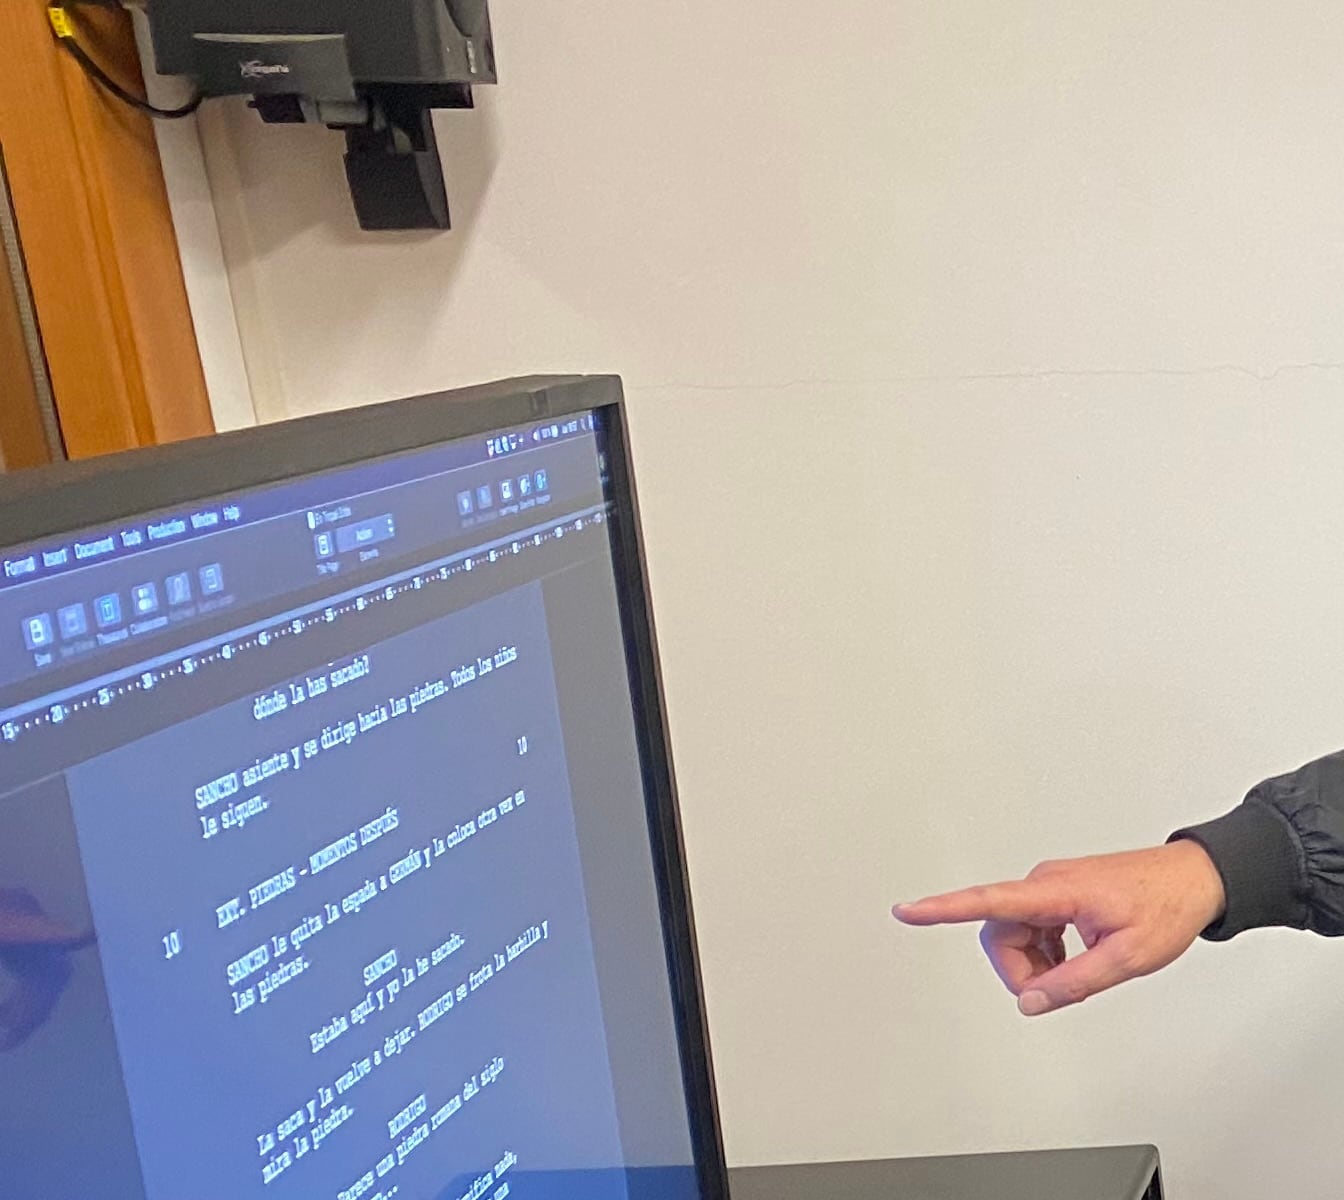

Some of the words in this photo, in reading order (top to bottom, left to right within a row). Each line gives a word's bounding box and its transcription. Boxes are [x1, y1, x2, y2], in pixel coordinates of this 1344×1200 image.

[254, 691, 288, 720] dónde
[290, 684, 305, 704] la
[306, 676, 328, 698] has
[330, 655, 370, 687] sacado?
[195, 772, 238, 810] SANCHO
[242, 759, 289, 788] asiente
[291, 747, 300, 769] y
[304, 739, 318, 758] se
[320, 721, 356, 749] dirige
[358, 704, 388, 732] hacia
[390, 698, 408, 717] las
[409, 680, 448, 713] piedras.
[451, 666, 475, 688] Todos
[478, 658, 492, 676] los
[494, 646, 518, 668] niños
[517, 736, 528, 754] 10
[200, 816, 218, 838] le
[221, 795, 268, 828] siguen.
[216, 898, 245, 929] EXT.
[249, 866, 296, 909] PIEDRAS
[310, 832, 358, 874] MOMENTOS
[359, 807, 399, 846] DESPUÉS
[227, 944, 269, 986] SANCHO
[272, 936, 287, 958] le
[290, 915, 323, 950] quita
[325, 904, 340, 924] la
[342, 880, 378, 912] espada
[380, 876, 387, 890] a
[424, 848, 430, 868] y
[433, 838, 445, 856] la
[447, 820, 476, 848] coloca
[478, 808, 497, 828] otra
[499, 797, 513, 815] vez
[514, 790, 525, 806] en
[162, 931, 180, 960] 10
[363, 949, 398, 986] SANCHO
[232, 988, 255, 1014] las
[258, 956, 309, 1003] piedras.
[310, 1016, 348, 1054] Estaba
[350, 991, 375, 1024] aquí
[376, 988, 384, 1010] y
[386, 978, 400, 1003] yo
[402, 968, 415, 986] la
[416, 958, 429, 976] he
[432, 933, 464, 966] sacado.
[257, 1132, 274, 1156] La
[277, 1110, 305, 1141] saca
[306, 1100, 316, 1123] y
[318, 1087, 334, 1108] la
[335, 1057, 371, 1094] vuelve
[374, 1051, 382, 1066] a
[384, 1026, 416, 1057] dejar.
[418, 991, 454, 1031] RODRIGO
[456, 984, 468, 1002] se
[469, 964, 494, 991] frota
[494, 954, 506, 972] la
[506, 926, 540, 962] barbilla
[542, 920, 548, 939] y
[262, 1152, 292, 1184] mira
[294, 1137, 310, 1158] la
[311, 1105, 354, 1150] piedra.
[376, 1154, 395, 1178] una
[396, 1123, 430, 1165] piedra
[431, 1095, 462, 1130] romana
[463, 1076, 479, 1101] del
[480, 1056, 504, 1086] siglo
[388, 1094, 426, 1139] RODRIGO
